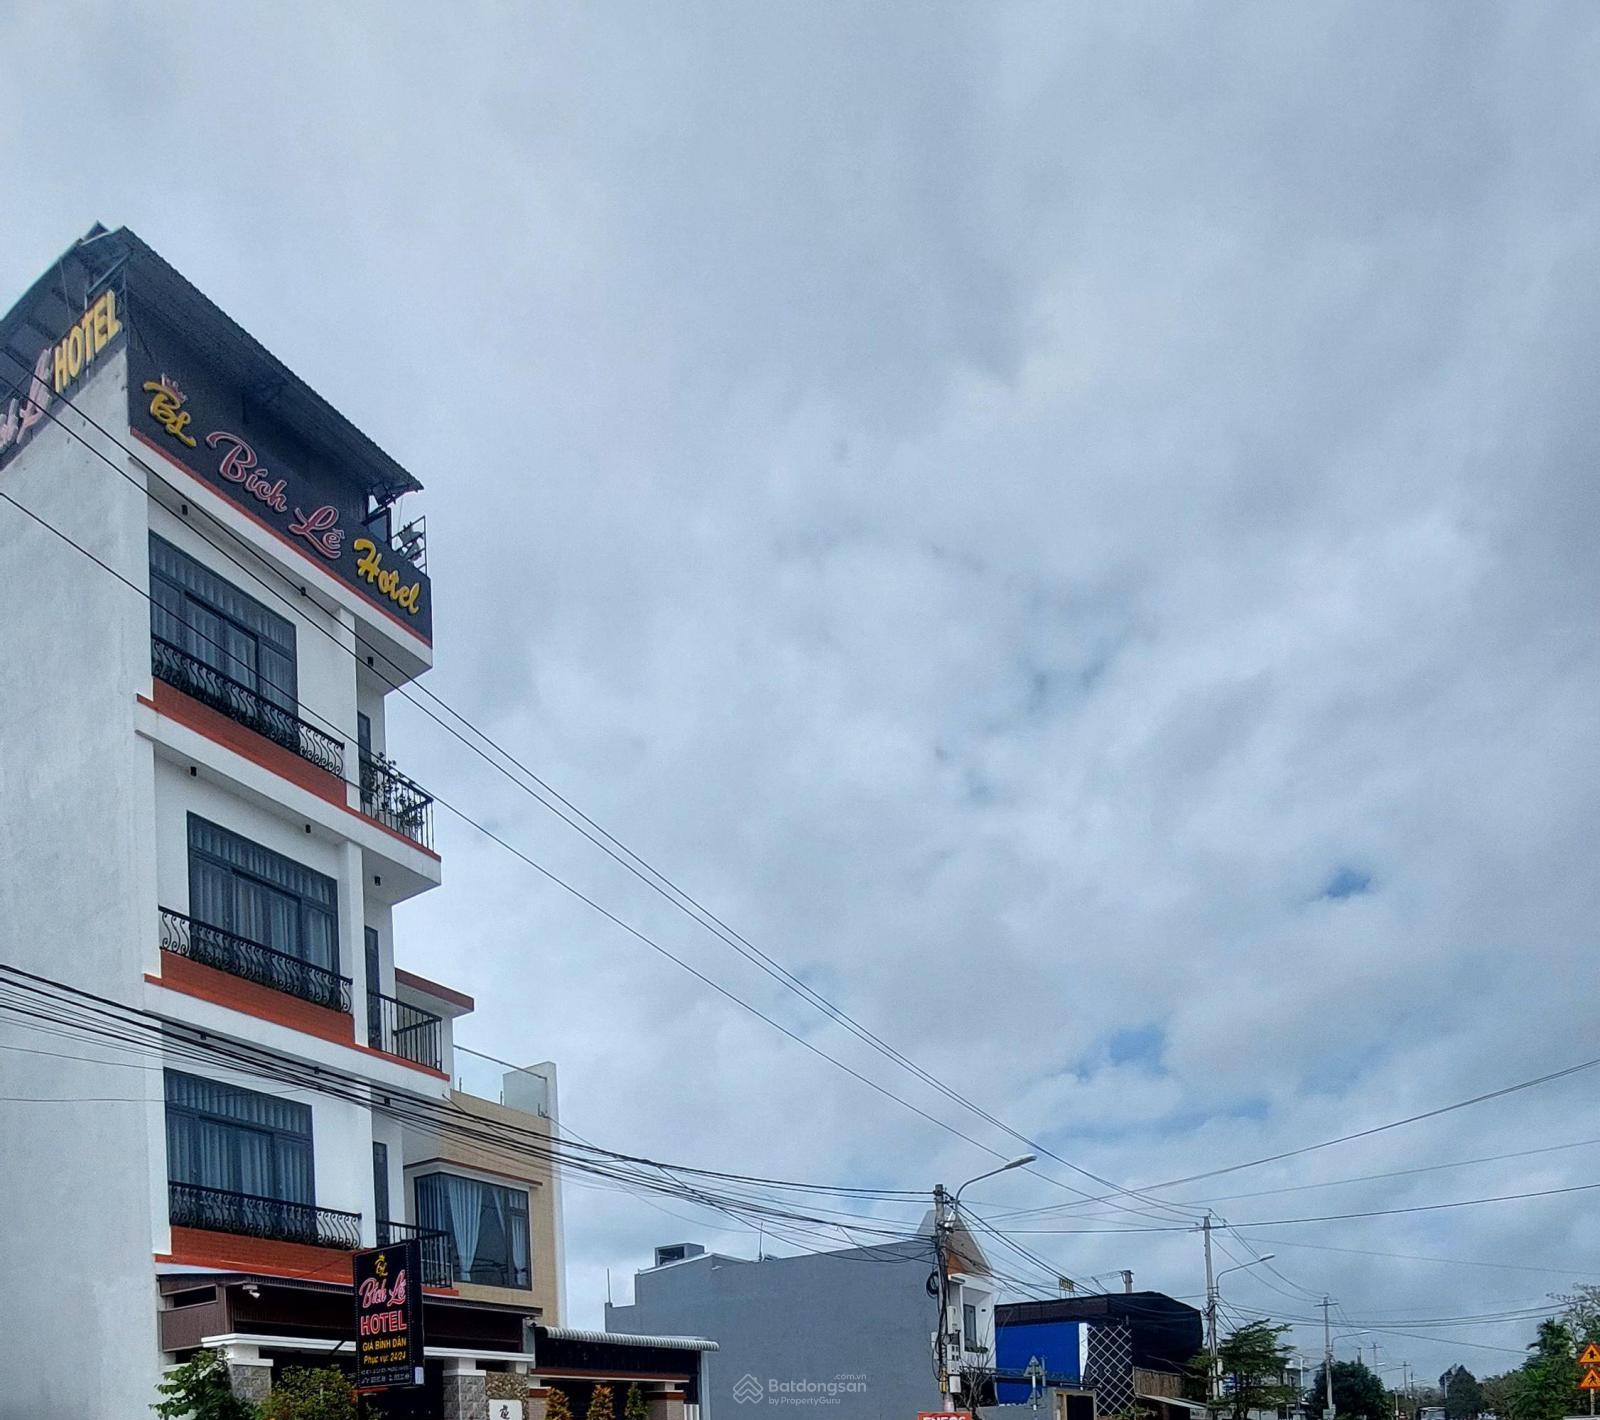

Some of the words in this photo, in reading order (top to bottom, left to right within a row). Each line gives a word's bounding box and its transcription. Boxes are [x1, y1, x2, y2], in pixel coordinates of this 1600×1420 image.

[54, 289, 122, 393] HOTEL
[205, 431, 288, 513] Bích
[288, 505, 345, 560] Lê
[353, 538, 420, 614] Hotel
[358, 1276, 387, 1308] Bích
[387, 1269, 407, 1307] Lê
[360, 1310, 407, 1336] HOTEL
[374, 1338, 391, 1350] BÌNH
[392, 1335, 407, 1348] DÂN
